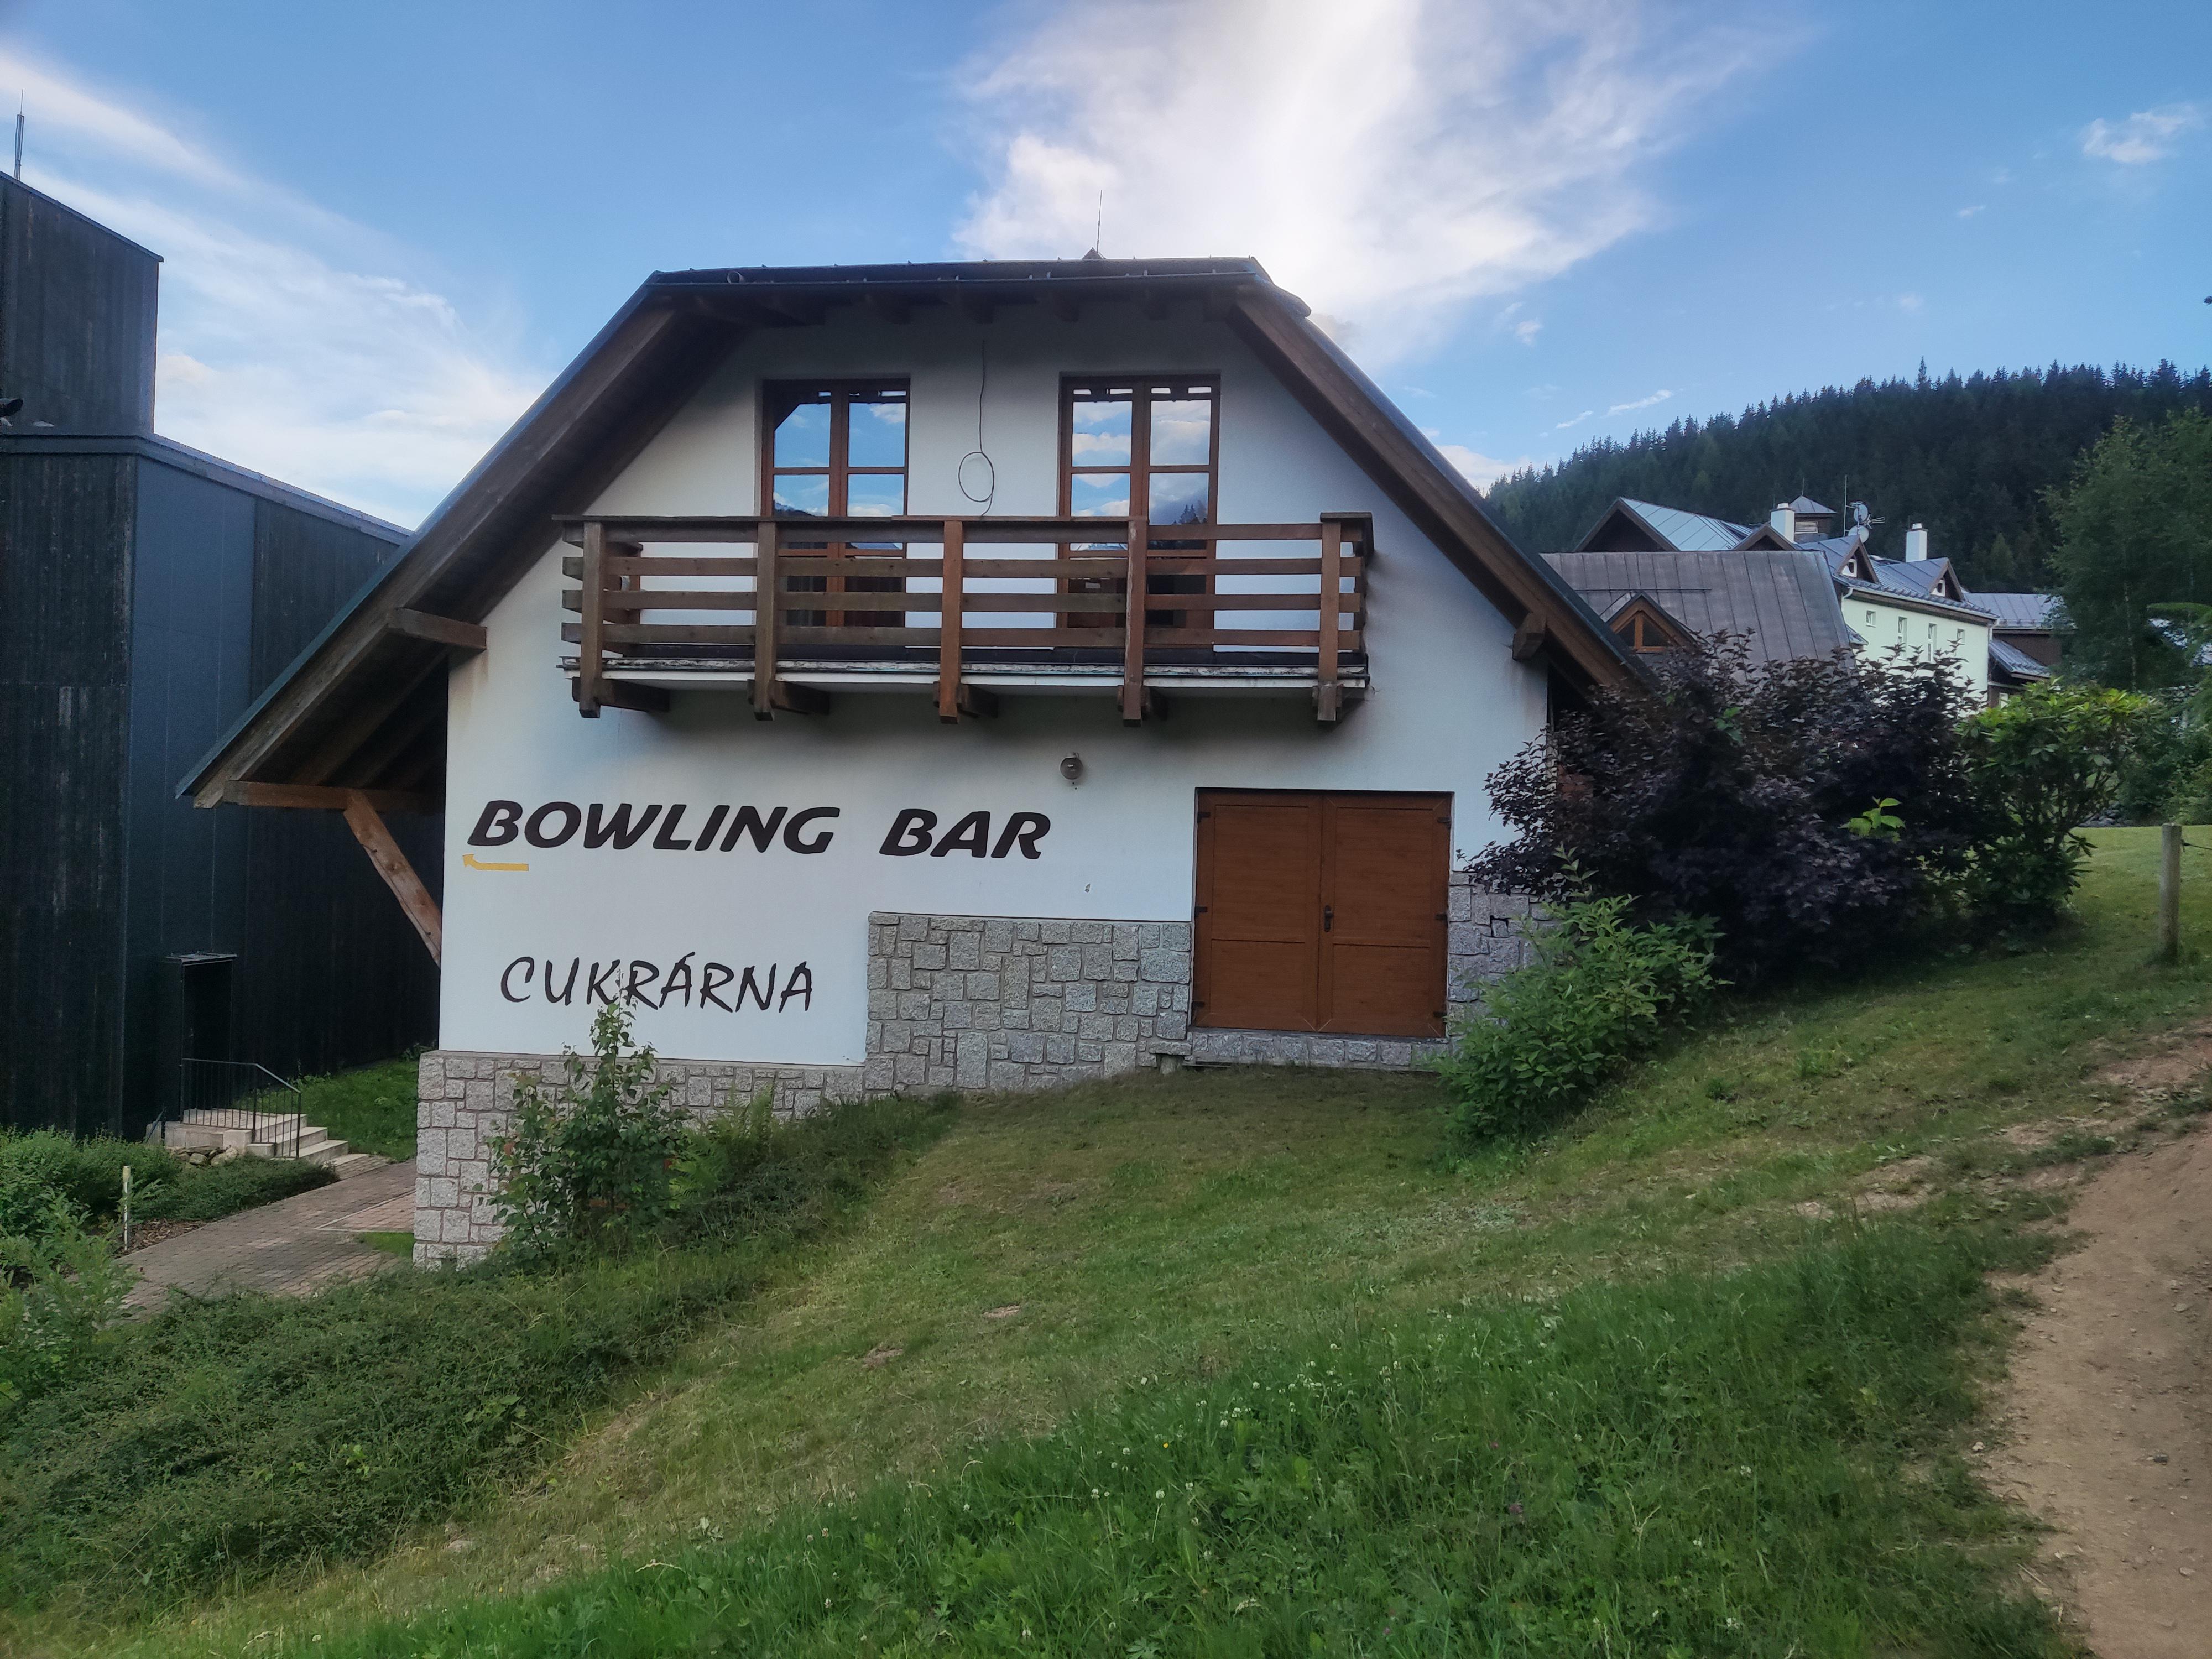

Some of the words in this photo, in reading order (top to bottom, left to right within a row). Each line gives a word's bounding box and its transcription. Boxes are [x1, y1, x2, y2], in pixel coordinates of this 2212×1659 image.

[467, 799, 841, 854] BOWLING
[878, 808, 1051, 860] BAR
[500, 951, 813, 1014] CUKRÁRNA
